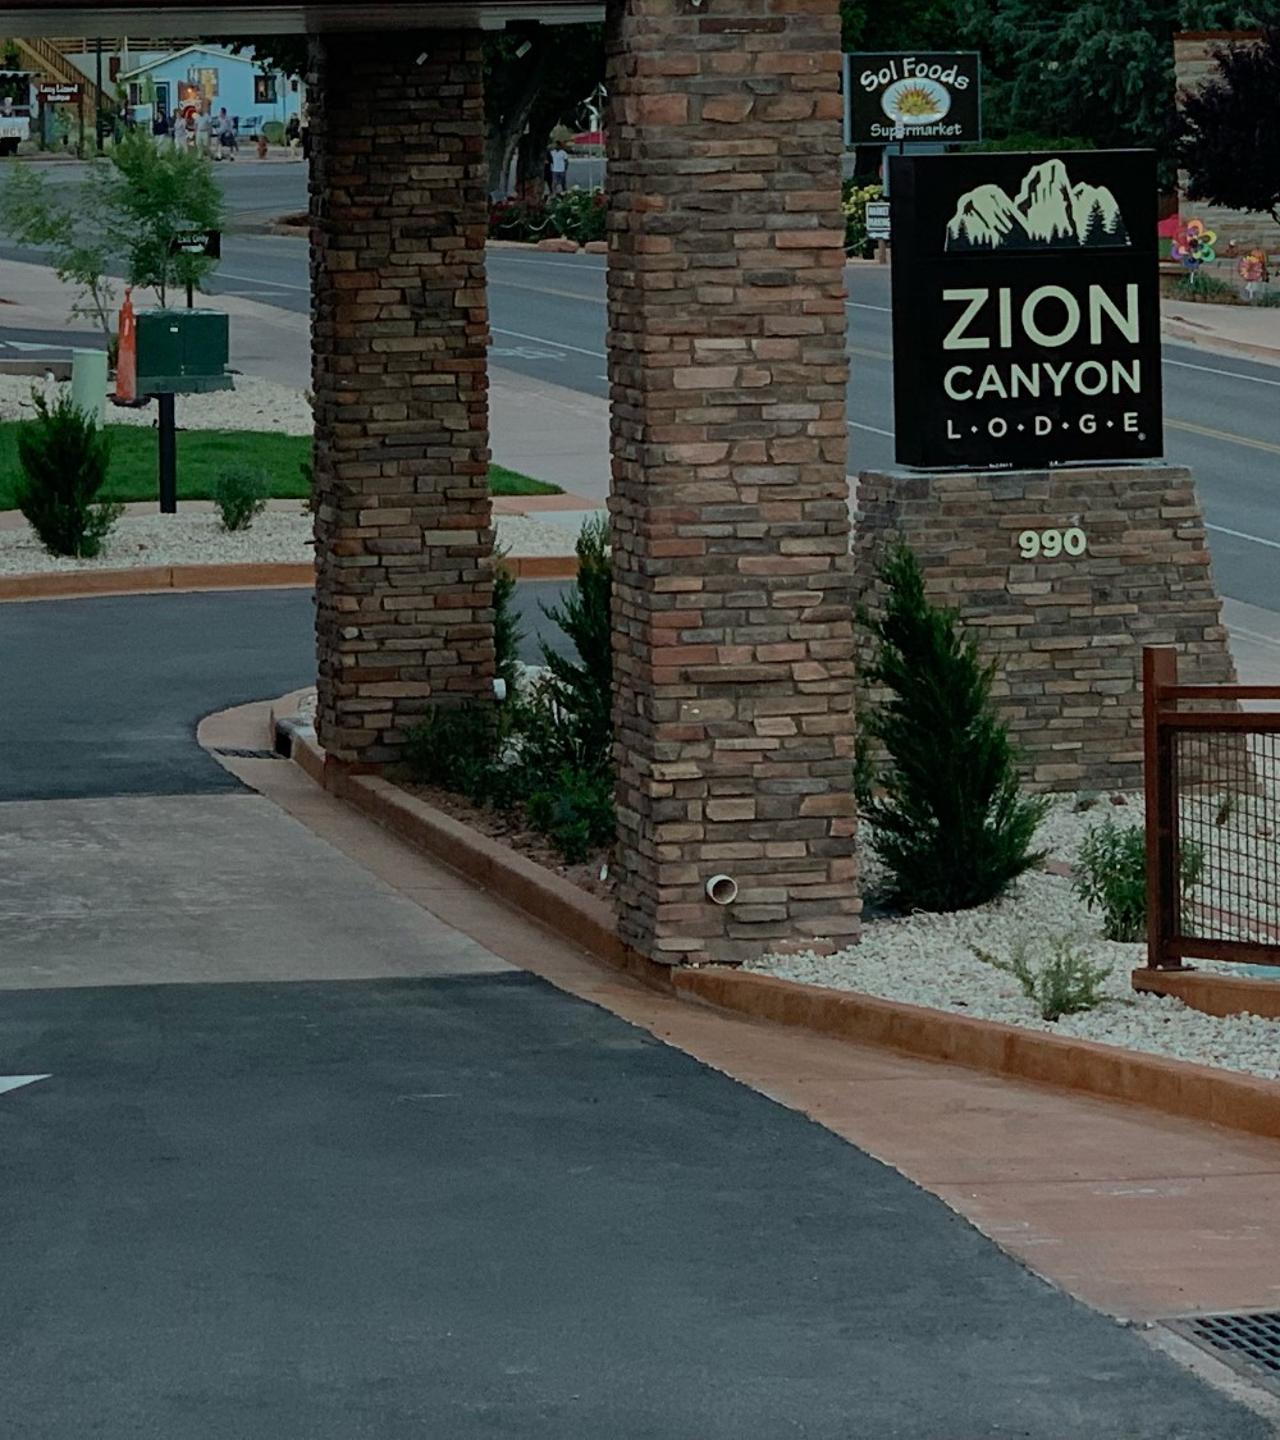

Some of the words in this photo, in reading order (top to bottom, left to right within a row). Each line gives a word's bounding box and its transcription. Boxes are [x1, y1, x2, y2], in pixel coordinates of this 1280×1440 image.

[860, 60, 898, 92] Sol
[902, 57, 970, 90] Foods
[942, 283, 1140, 350] ZION
[943, 359, 1141, 401] CANYON
[1019, 527, 1087, 558] 990
